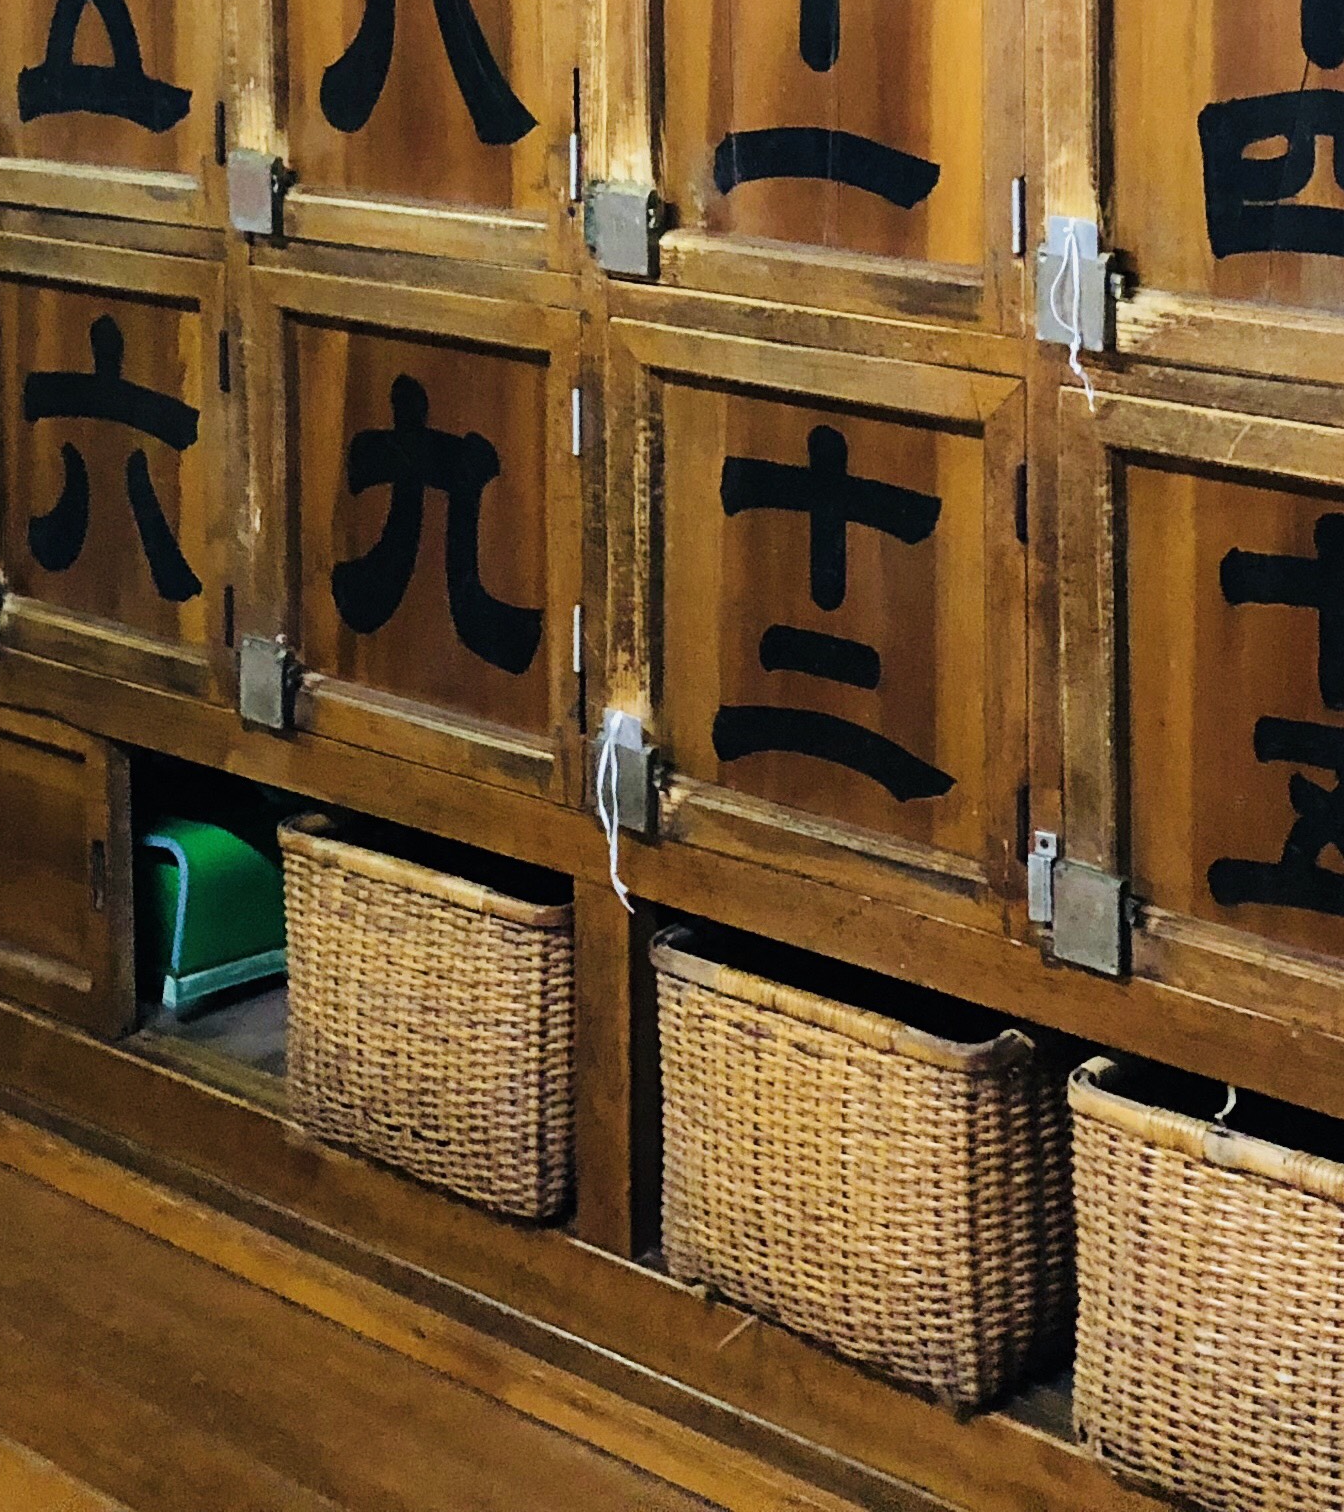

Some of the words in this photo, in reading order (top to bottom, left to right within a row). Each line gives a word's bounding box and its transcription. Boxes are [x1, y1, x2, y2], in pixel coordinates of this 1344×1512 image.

[24, 314, 202, 602] 六
[332, 374, 543, 674] 九
[712, 424, 958, 801] 十二
